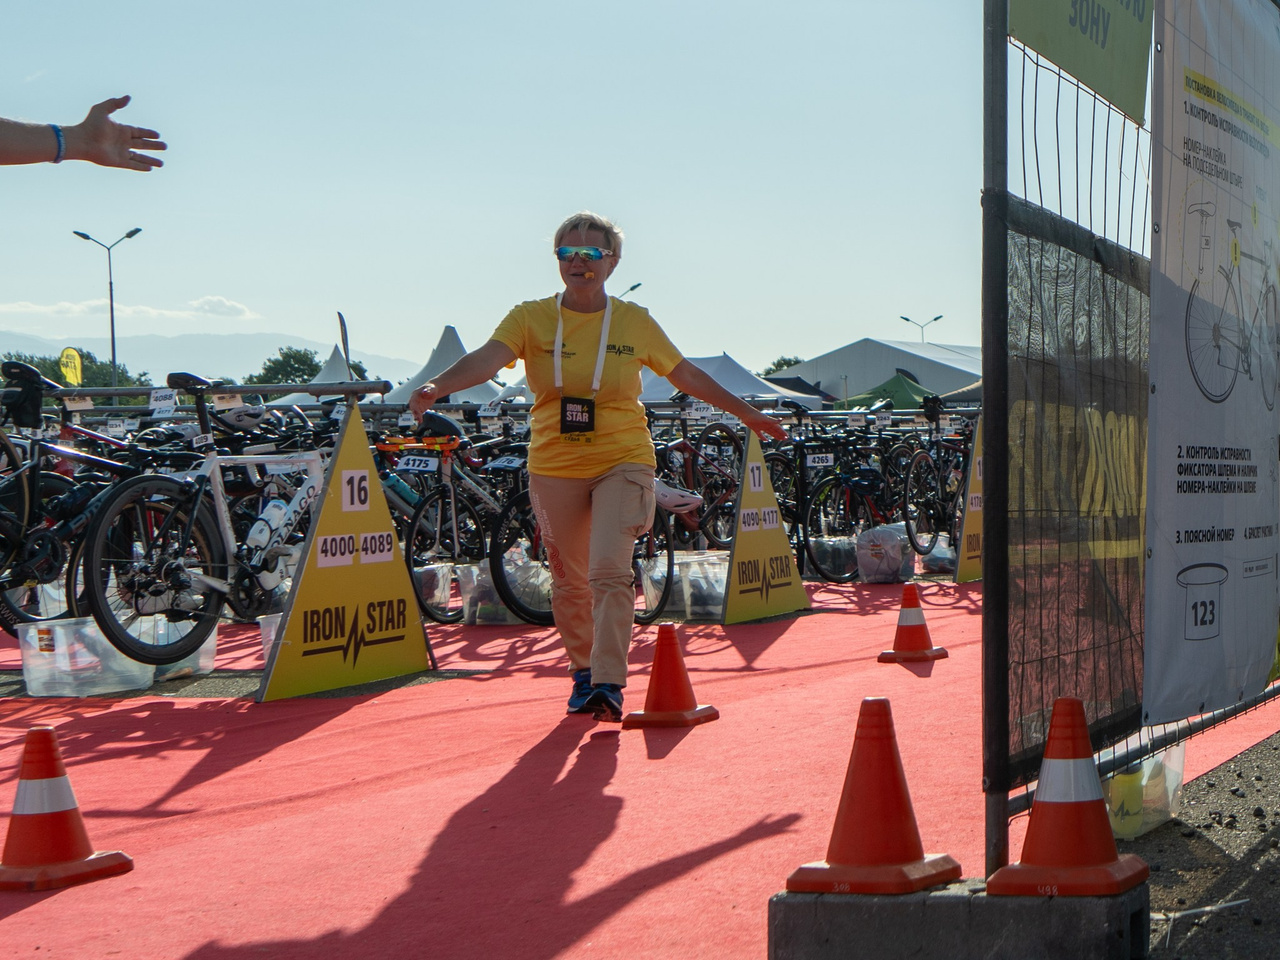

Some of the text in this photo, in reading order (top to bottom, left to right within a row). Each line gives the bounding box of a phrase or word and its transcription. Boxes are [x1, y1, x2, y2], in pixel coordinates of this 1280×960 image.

[1185, 76, 1216, 100] ПОСТАНОВКА
[1190, 102, 1219, 128] КОНТРОЛЬ
[1183, 136, 1227, 166] НОМЕР-НАКЛЕЙКА
[1183, 152, 1192, 168] НА
[622, 344, 635, 353] STAR
[154, 393, 173, 402] 4088
[566, 403, 582, 412] IRON
[566, 411, 589, 423] STAR
[811, 455, 829, 464] 4265
[1177, 445, 1252, 461] 2. КОНТРОЛЬ ИСПРАВНОСТИ
[403, 457, 430, 469] 4175
[1177, 463, 1217, 477] ФИКСАТОРА
[1217, 464, 1237, 477] ШЛЕМА
[750, 465, 762, 489] 17
[1177, 478, 1257, 493] НОМЕРА-НАКЛЕЙКИ НА ШЛЕМЕ
[346, 476, 369, 506] 16
[271, 485, 315, 548] OLNAGO
[966, 534, 981, 553] IRON
[1176, 526, 1235, 544] 3. ПОЯСНОЙ НОМЕР
[737, 555, 791, 586] IRON STAR
[303, 598, 407, 644] IRON STAR
[1191, 600, 1216, 627] 123
